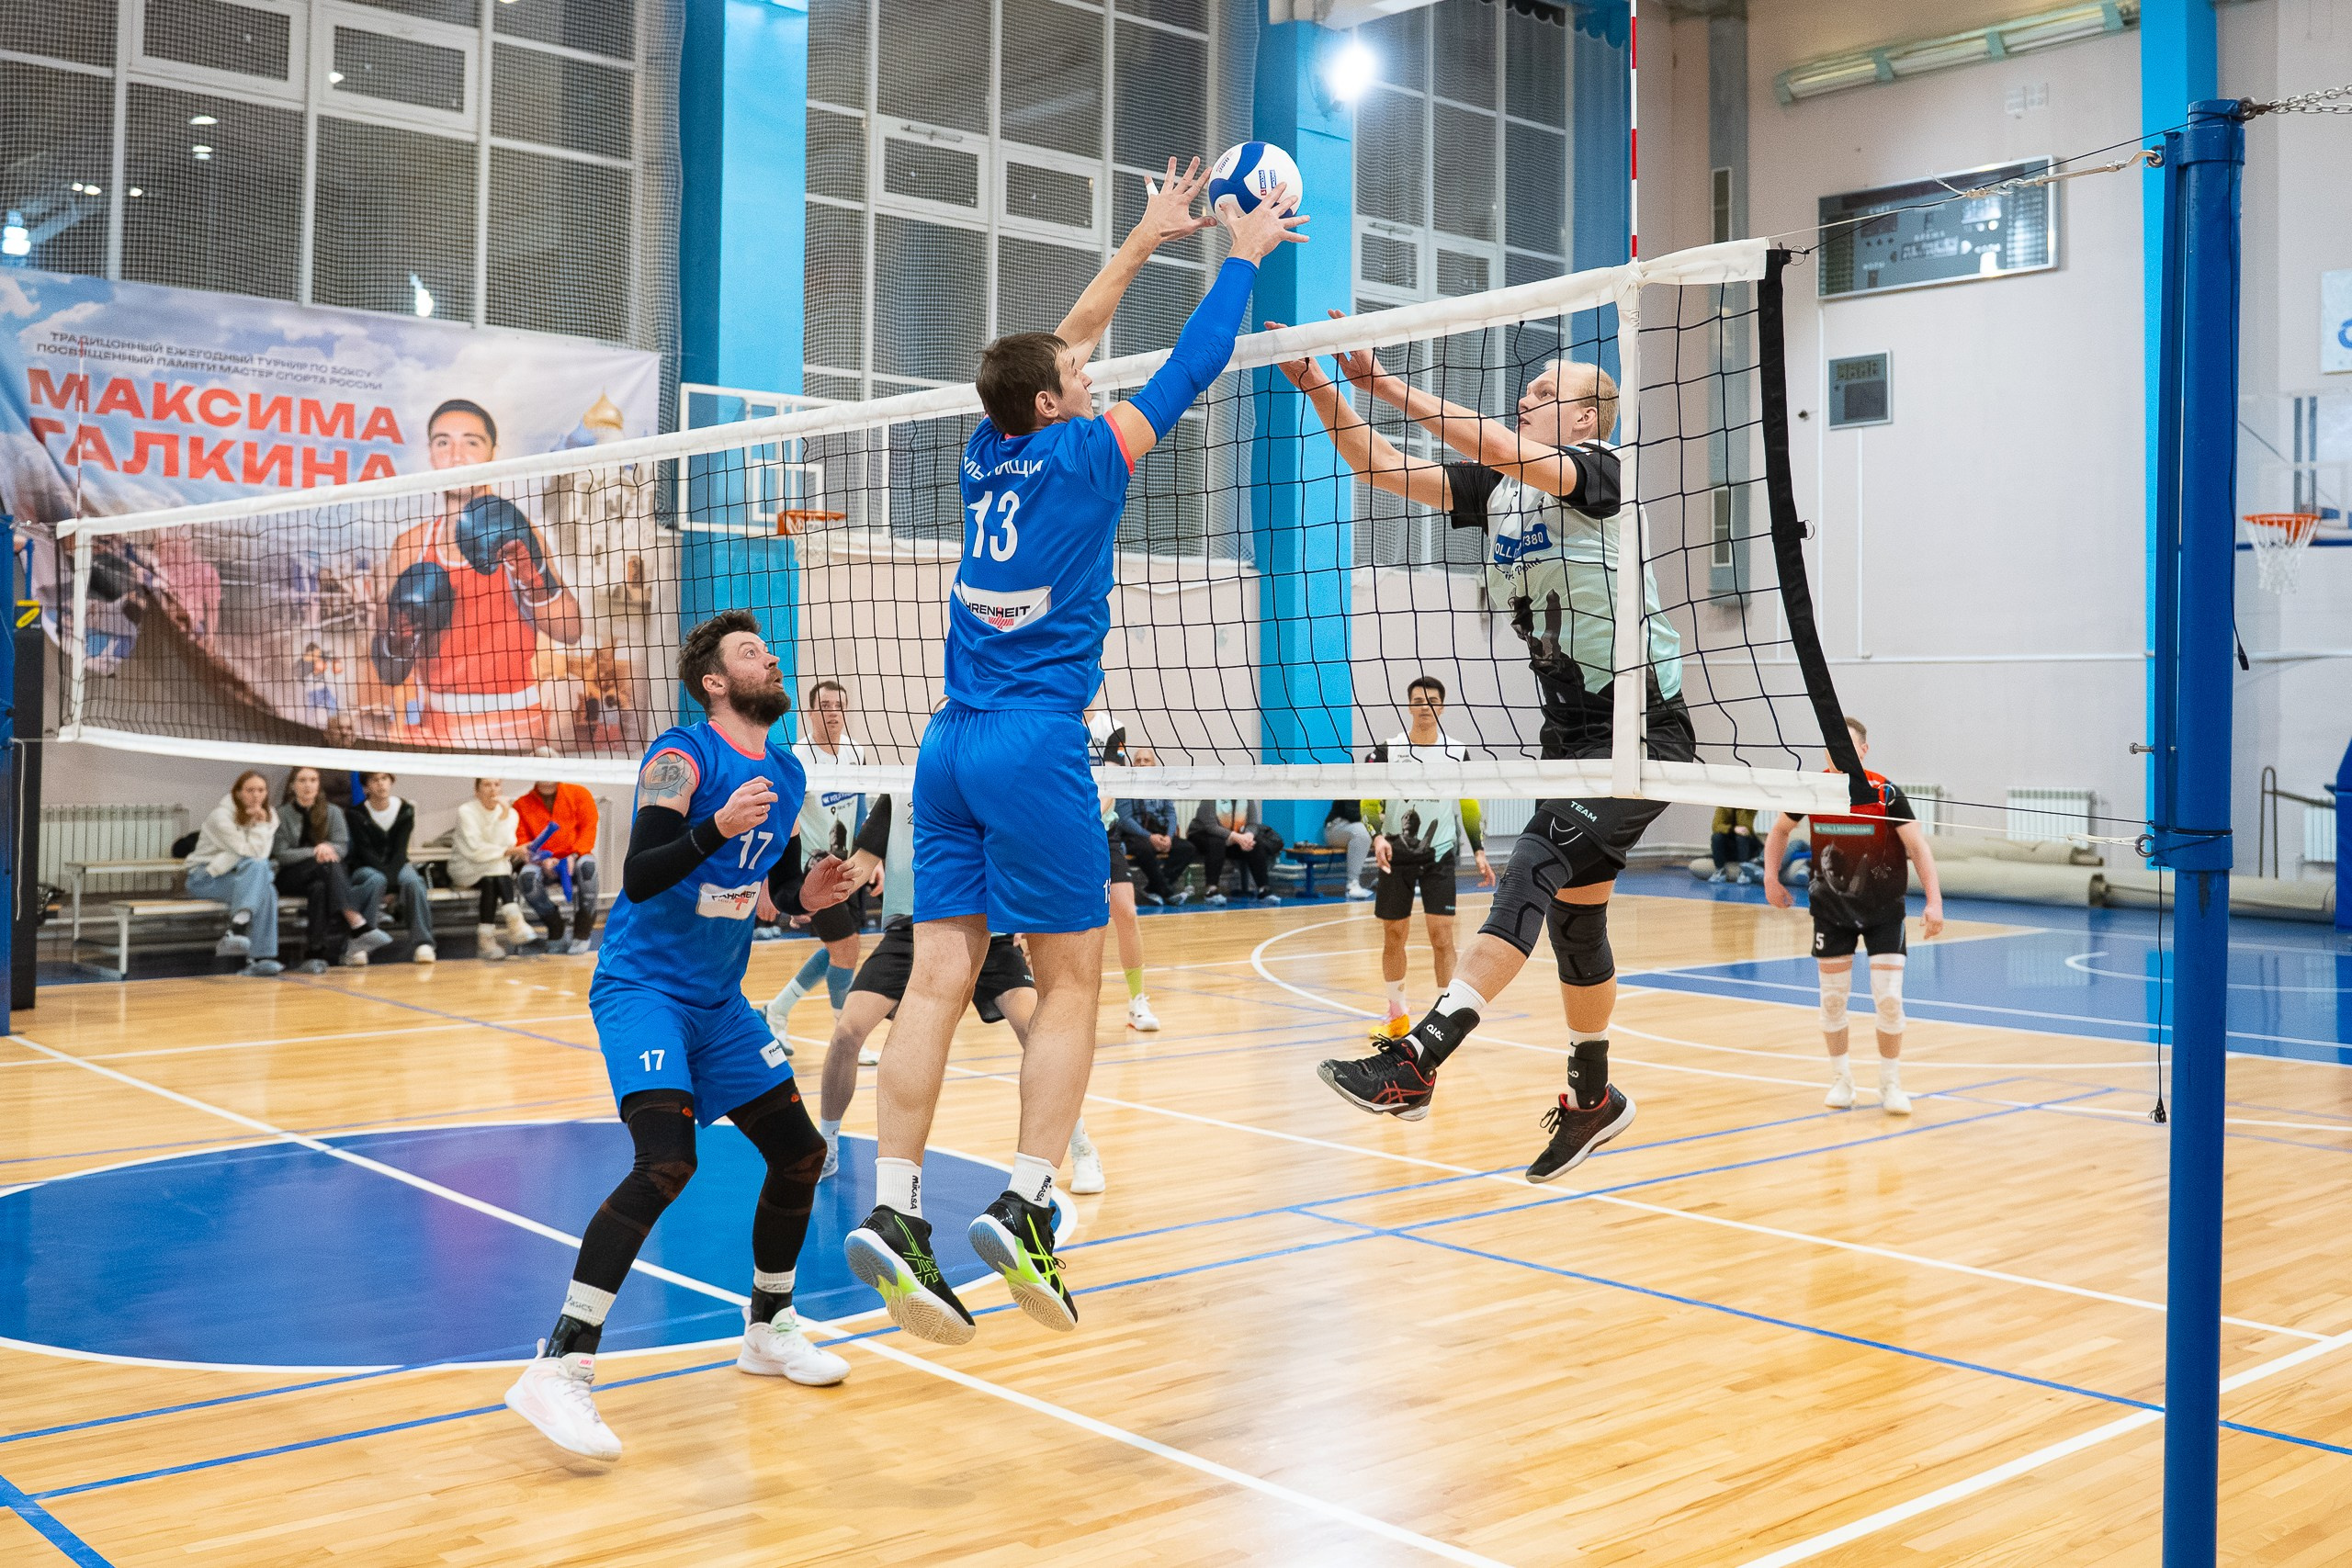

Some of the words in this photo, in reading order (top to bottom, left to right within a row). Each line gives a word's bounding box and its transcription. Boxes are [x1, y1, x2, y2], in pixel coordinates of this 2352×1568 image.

[157, 356, 217, 373] ПАМЯТИ
[219, 366, 273, 379] МАСТЕР
[276, 370, 326, 384] СПОРТА
[329, 378, 383, 390] РОССИИ
[165, 345, 254, 366] ЕЖЕГОДНЫЙ
[257, 355, 308, 369] ТУРНИР
[311, 363, 328, 373] ПО
[331, 367, 374, 378] БОКСУ
[27, 367, 404, 446] МАКСИМА
[29, 416, 397, 489] ГАЛКИНА
[967, 490, 1021, 562] 13
[1570, 800, 1598, 823] TEAM
[739, 829, 774, 870] 17
[1815, 931, 1825, 950] 5
[639, 1048, 666, 1072] 17
